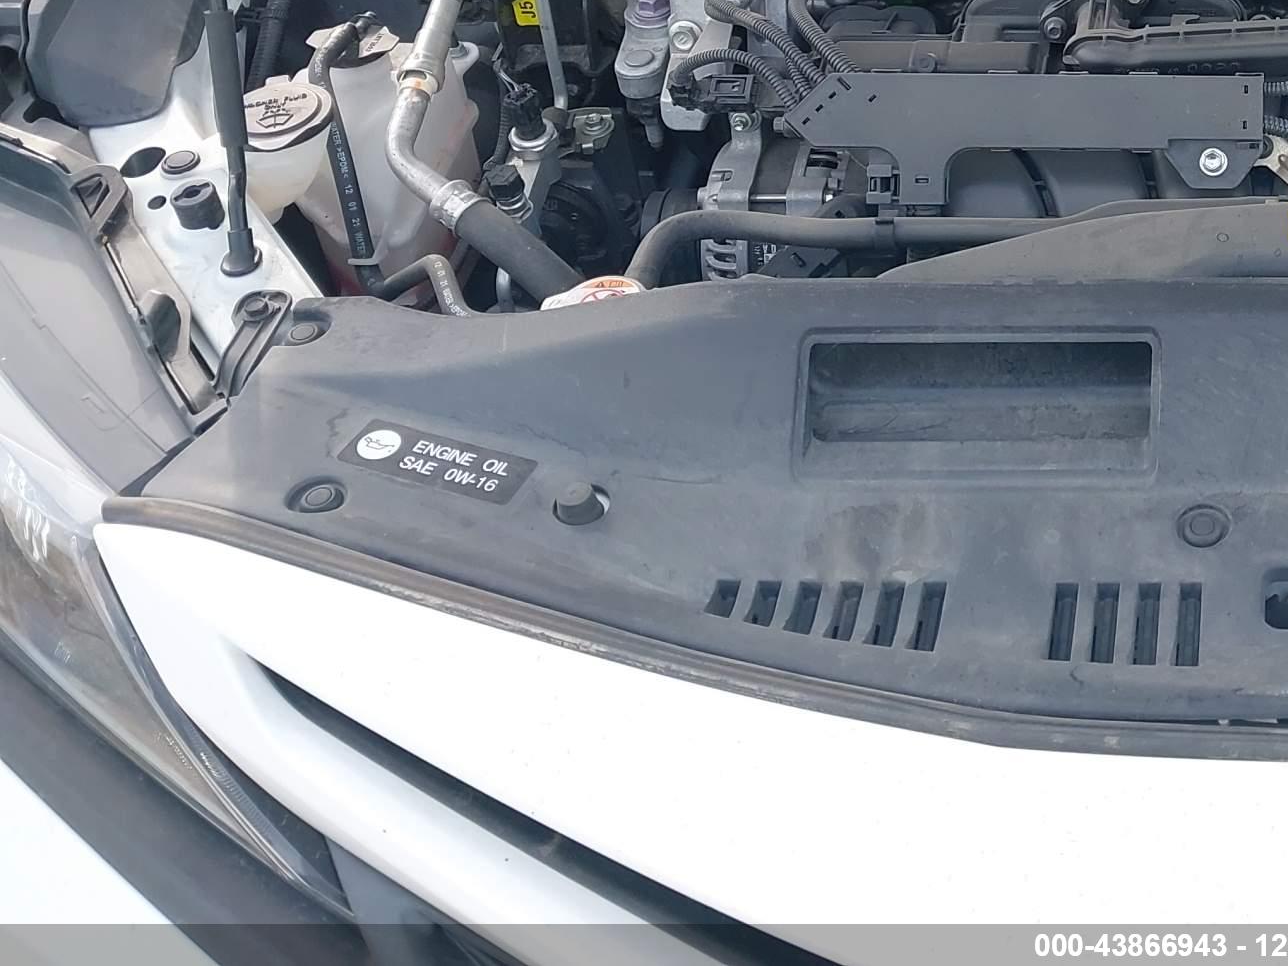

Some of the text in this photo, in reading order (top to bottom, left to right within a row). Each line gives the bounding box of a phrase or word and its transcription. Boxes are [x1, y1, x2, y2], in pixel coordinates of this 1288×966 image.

[519, 1, 536, 18] J5
[344, 184, 354, 195] 12
[412, 440, 508, 476] ENGINE OIL
[399, 456, 498, 492] SAE 0W-16
